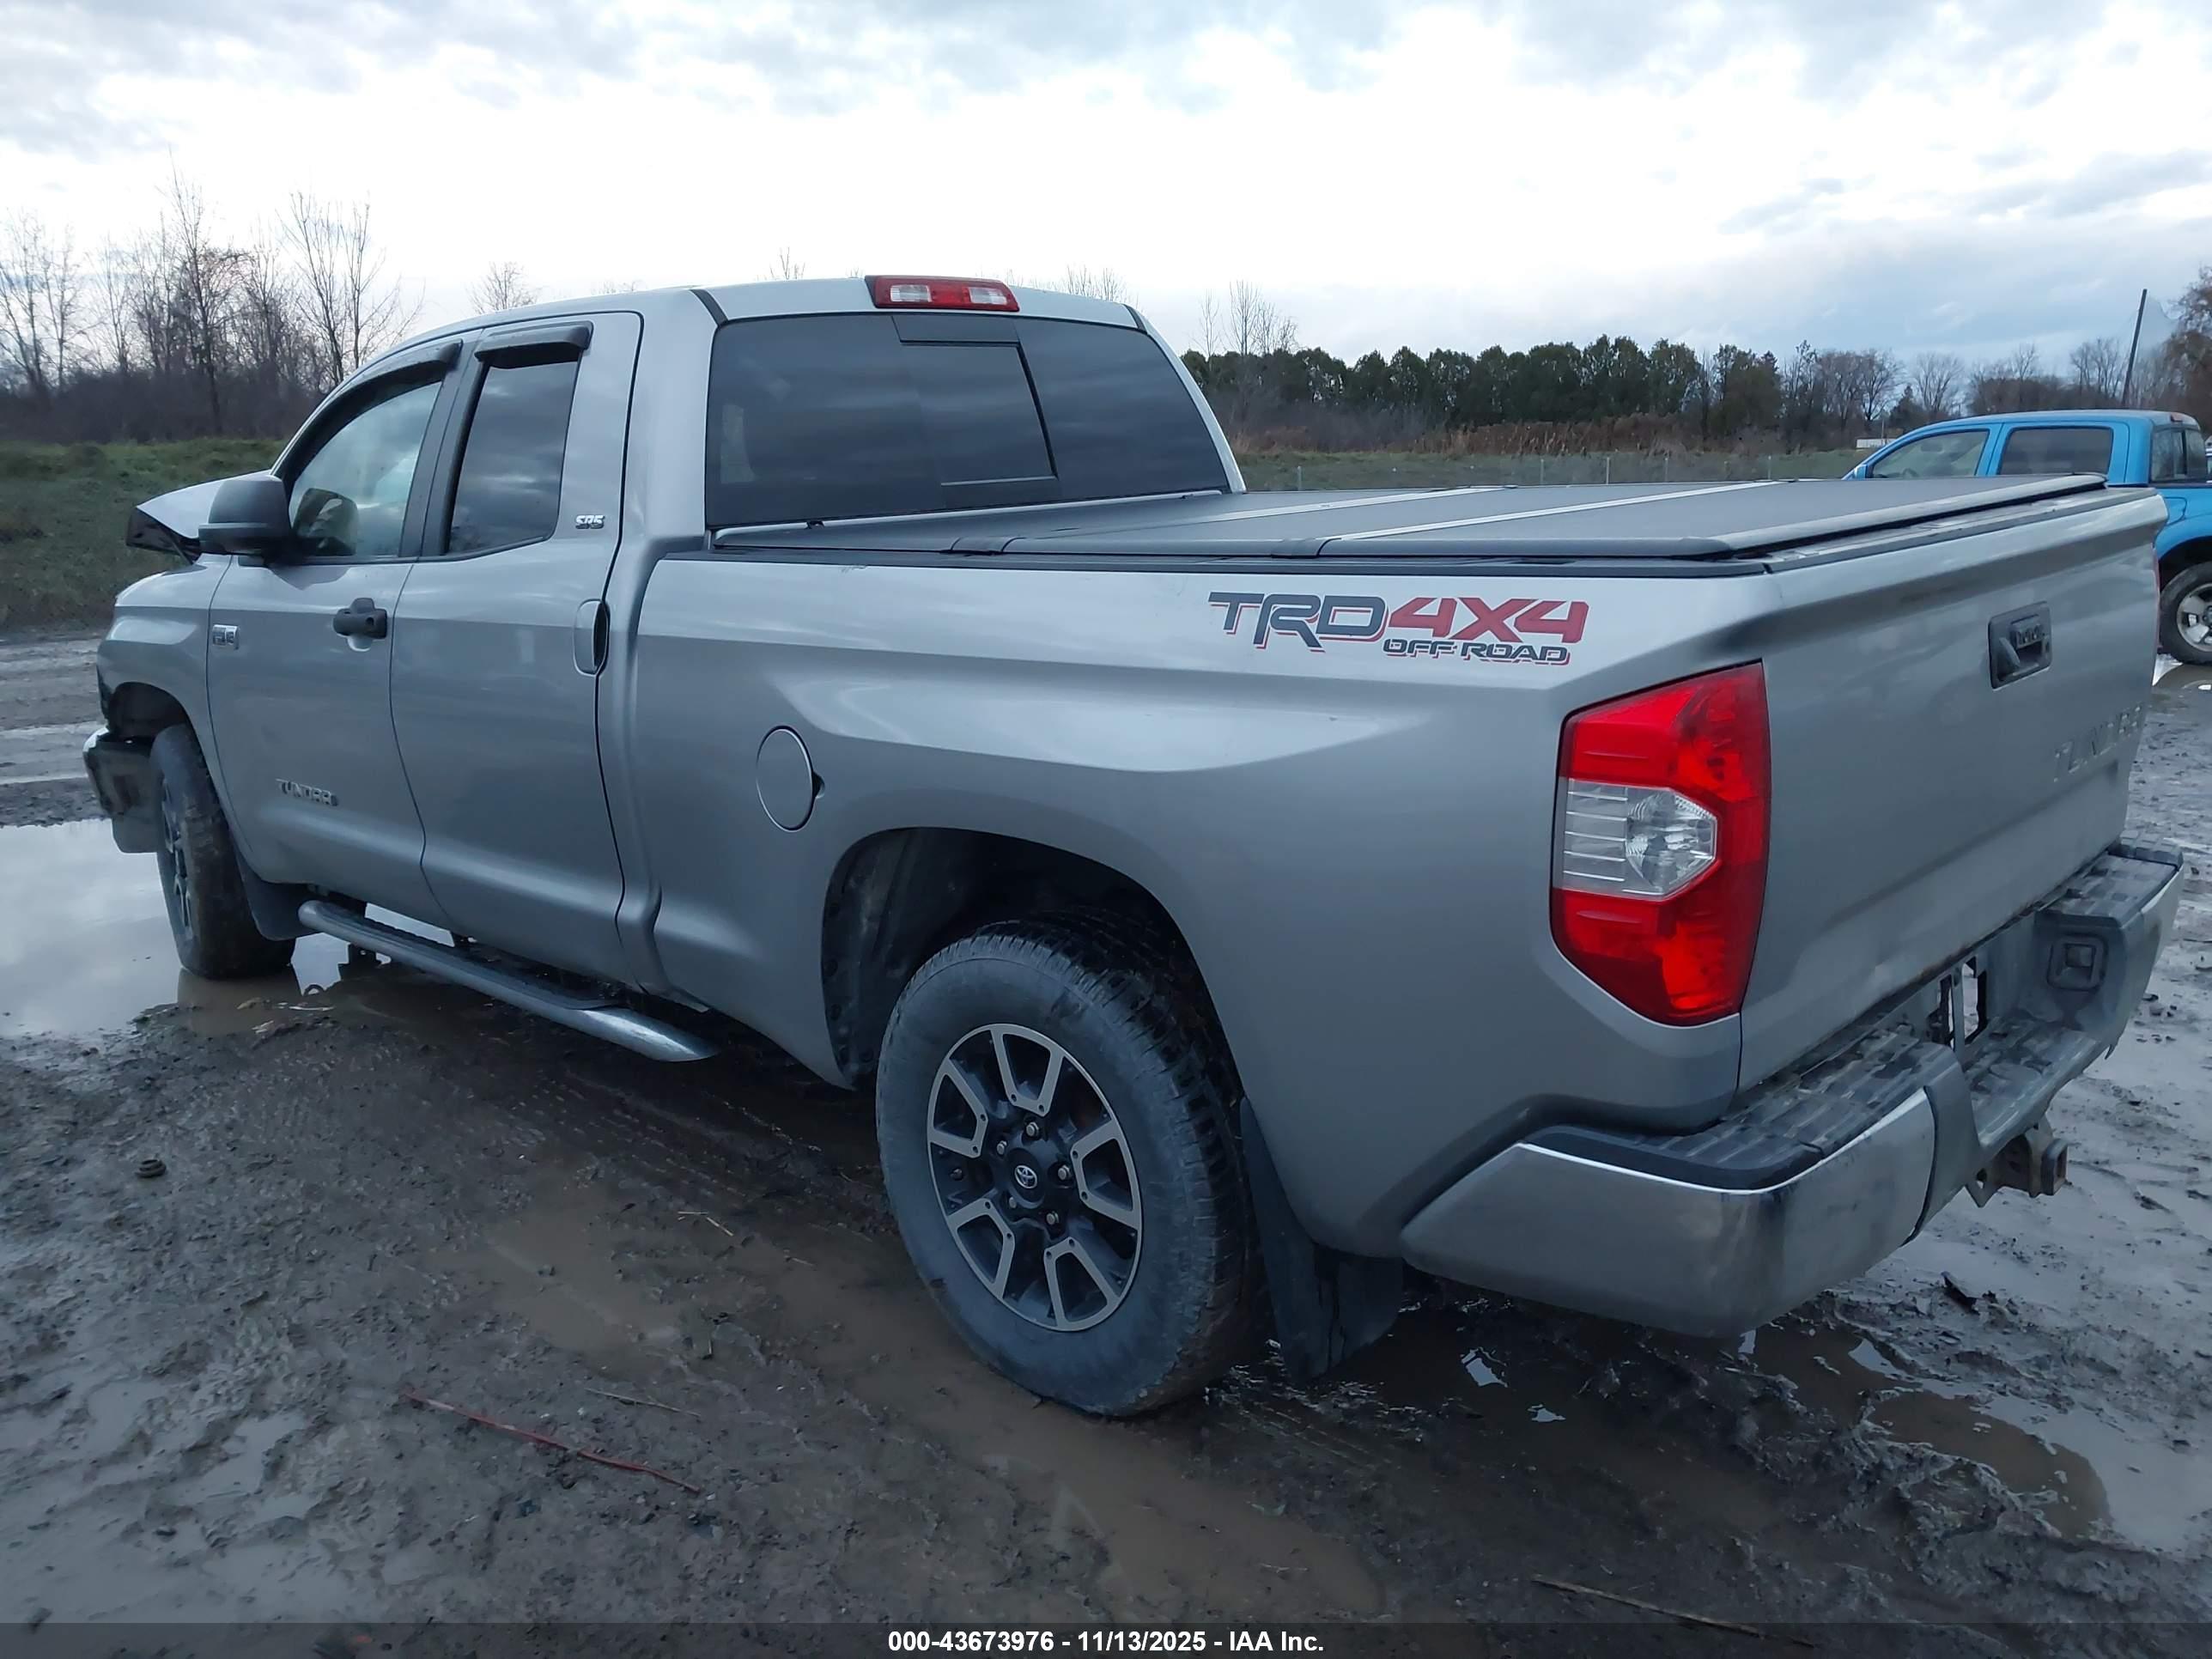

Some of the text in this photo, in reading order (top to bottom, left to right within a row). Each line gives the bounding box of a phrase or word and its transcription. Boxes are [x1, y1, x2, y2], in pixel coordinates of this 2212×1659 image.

[1208, 592, 1389, 653] TRD
[1382, 637, 1571, 665] OFF ROAD
